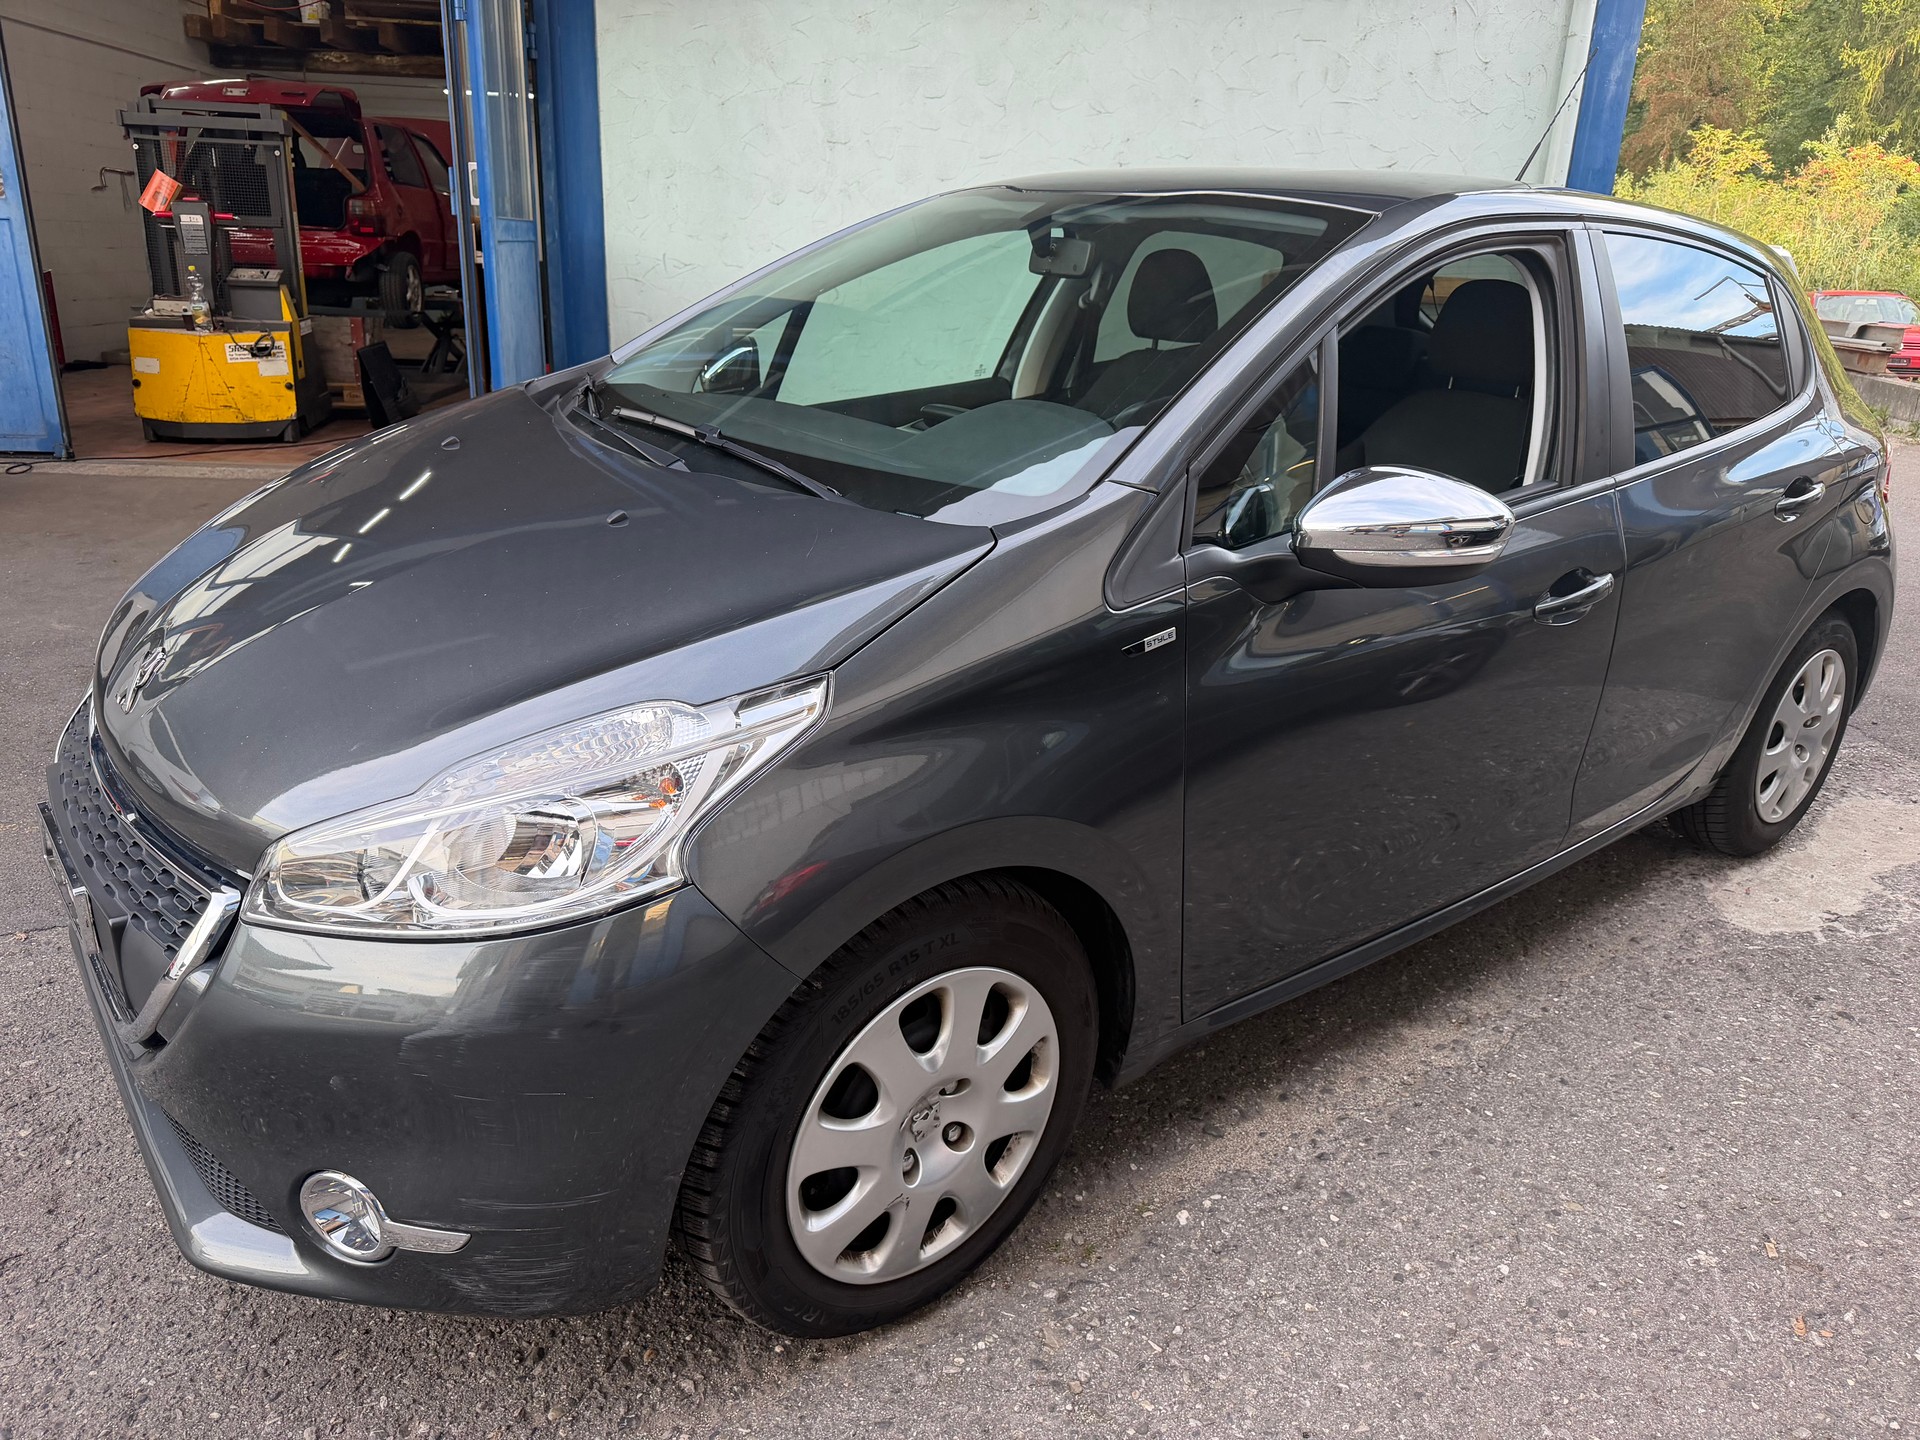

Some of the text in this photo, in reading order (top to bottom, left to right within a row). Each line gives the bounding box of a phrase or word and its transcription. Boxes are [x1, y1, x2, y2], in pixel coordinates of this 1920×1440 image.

[1146, 631, 1174, 648] STYLE
[830, 932, 961, 1025] 185/65 R15 T XL
